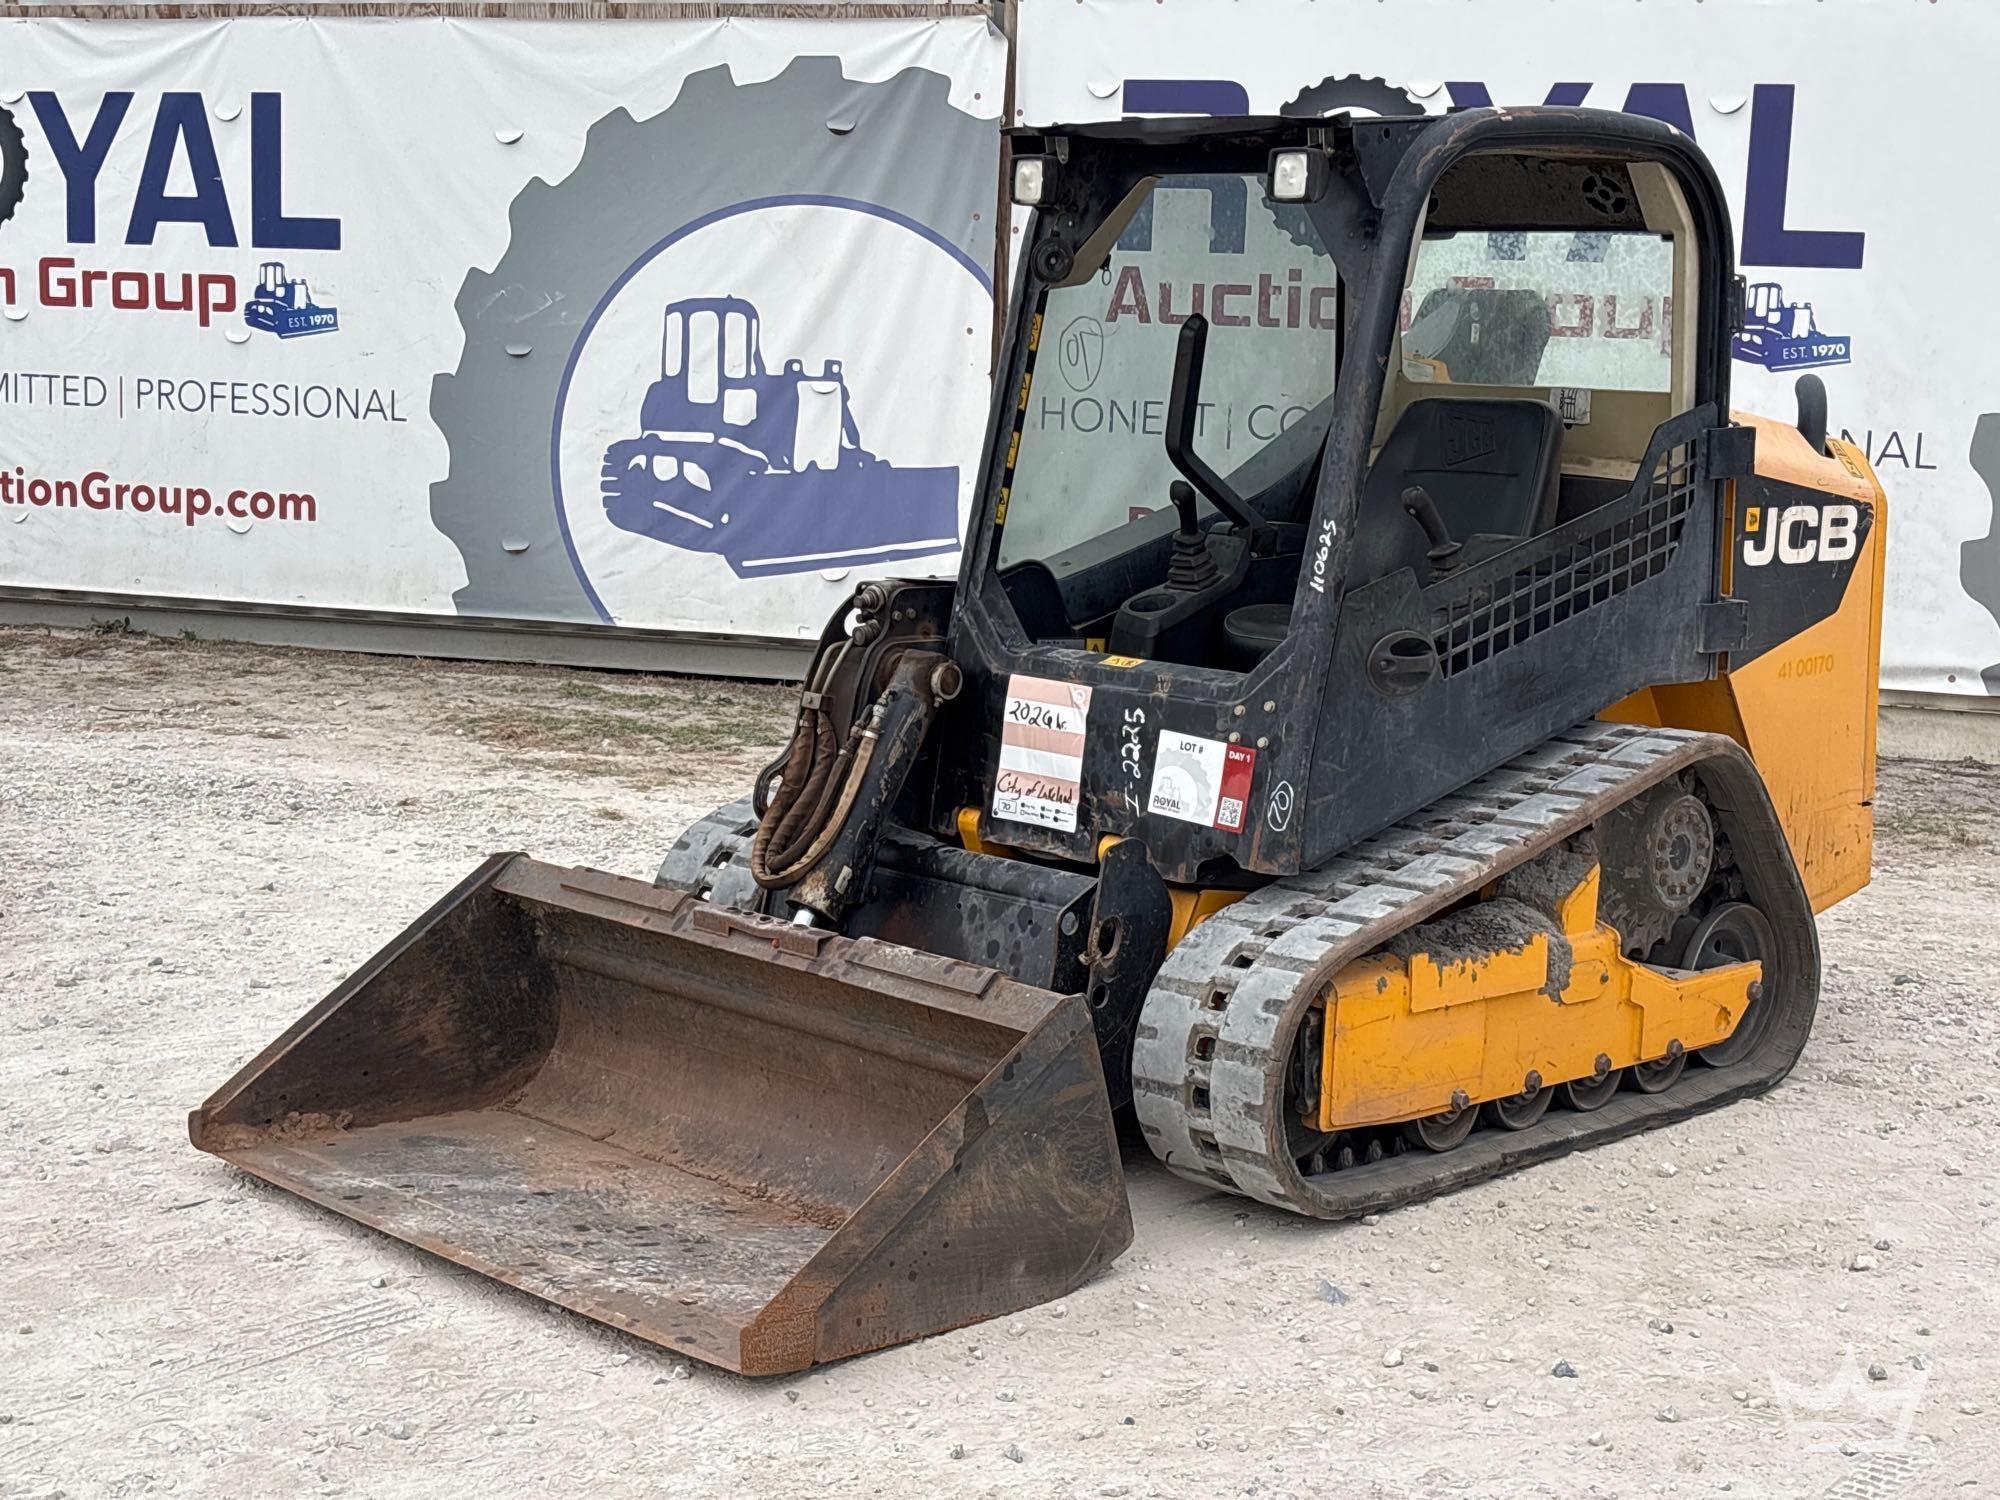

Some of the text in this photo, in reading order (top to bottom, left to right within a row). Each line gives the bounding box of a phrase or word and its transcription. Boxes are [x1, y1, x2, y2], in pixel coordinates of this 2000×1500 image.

[0, 91, 341, 251] YAL
[39, 257, 236, 327] Group
[288, 314, 334, 328] EST. 1970
[1782, 343, 1846, 359] EST. 1970
[137, 378, 407, 422] PROFESSIONAL
[1041, 396, 1215, 438] HONET
[1744, 504, 1858, 566] JCB
[1179, 741, 1197, 753] LOT
[1229, 751, 1246, 762] DAY
[997, 772, 1022, 801] City
[1025, 781, 1041, 796] of
[1153, 795, 1181, 810] ROYAL
